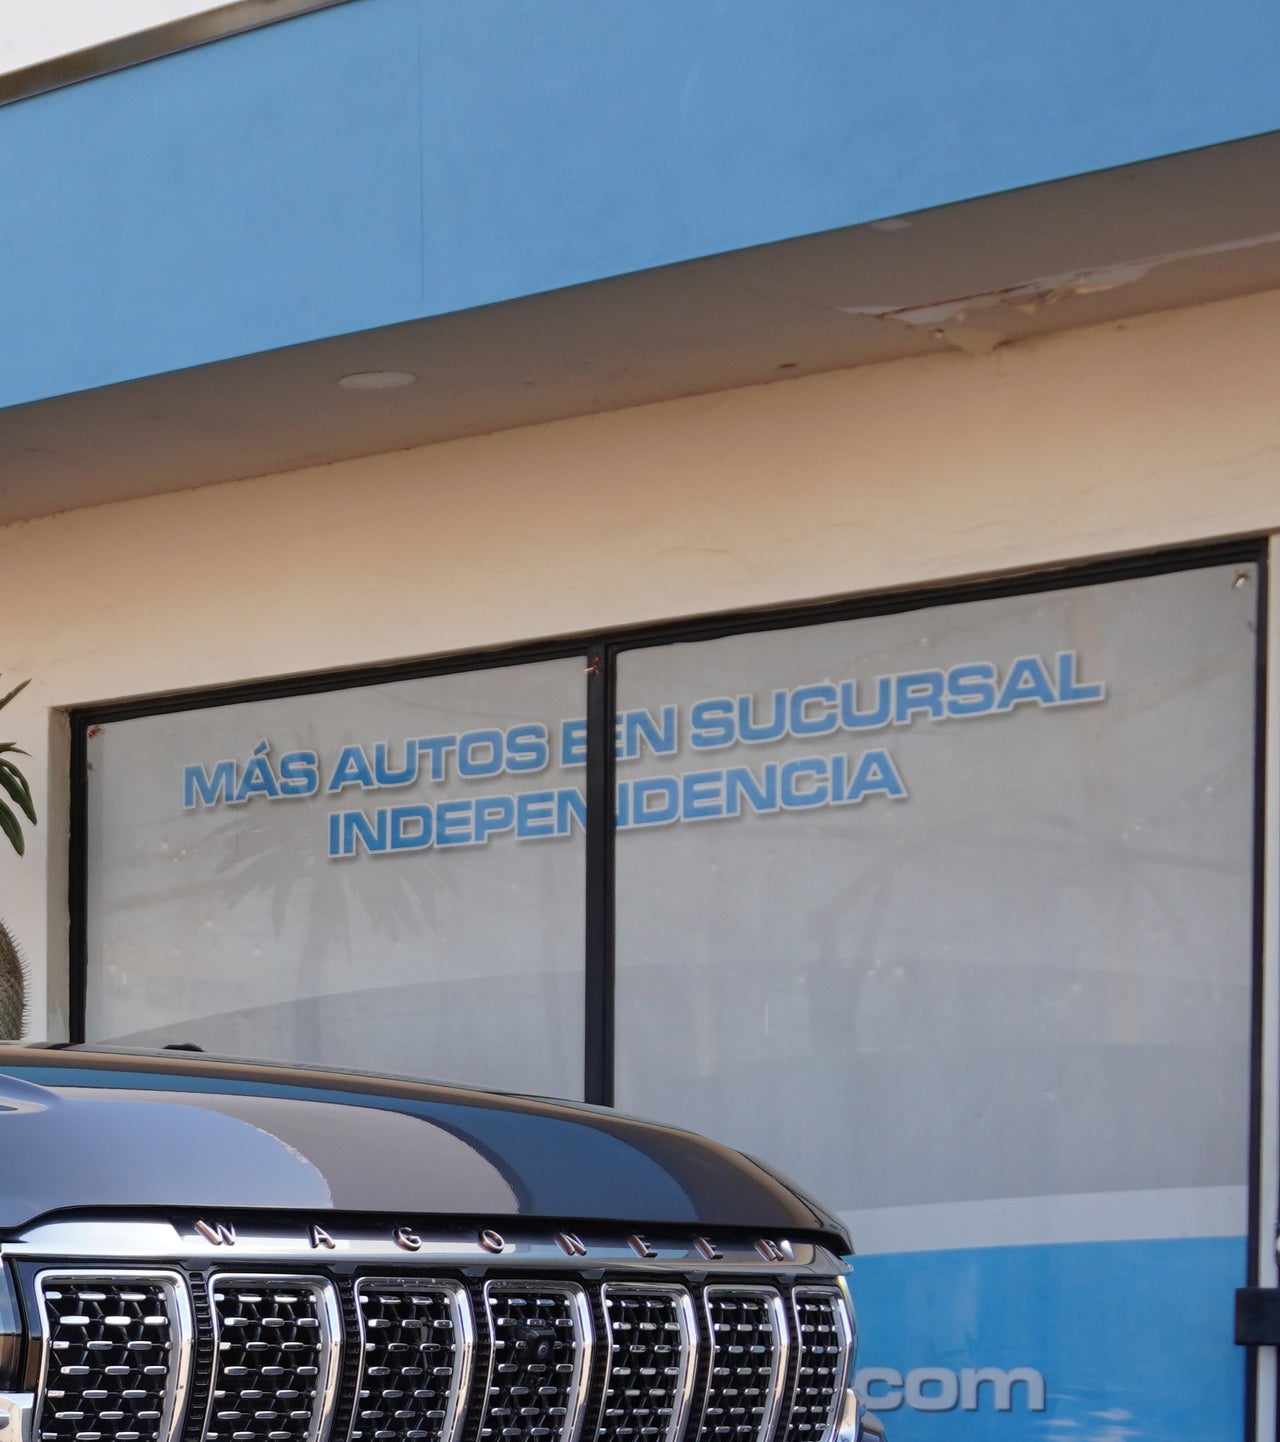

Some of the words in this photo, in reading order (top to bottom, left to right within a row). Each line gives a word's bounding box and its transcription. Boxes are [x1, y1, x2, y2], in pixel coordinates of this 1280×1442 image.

[184, 737, 319, 808] MÁS
[327, 722, 549, 793] AUTOS
[560, 703, 678, 768] EN
[690, 650, 1107, 751] SUCURSAL
[327, 747, 908, 858] INDEPENDENCIA
[194, 1219, 790, 1262] WAGONEER
